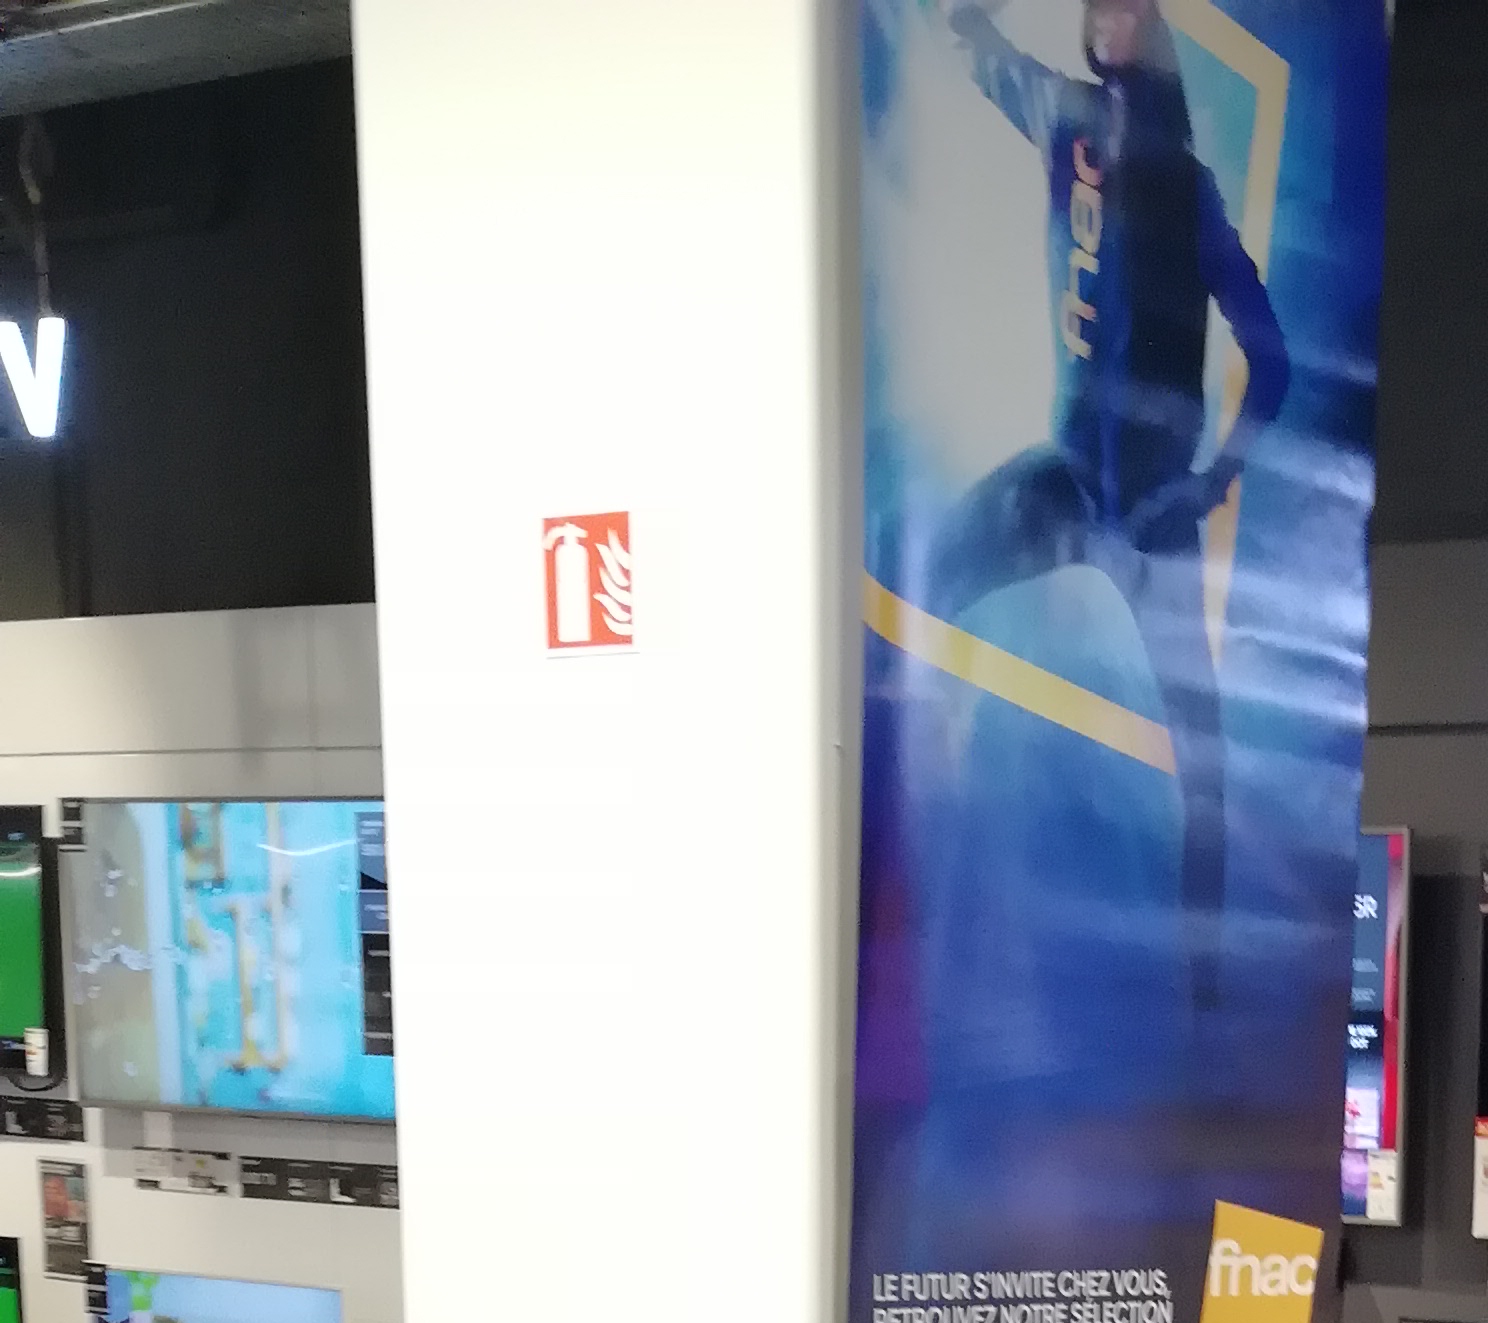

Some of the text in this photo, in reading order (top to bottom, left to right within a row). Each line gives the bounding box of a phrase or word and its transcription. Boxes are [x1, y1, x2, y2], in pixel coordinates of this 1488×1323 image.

[872, 1272, 899, 1302] LE
[901, 1270, 972, 1302] FUTUR
[973, 1269, 1056, 1300] S'INVITE
[1057, 1269, 1112, 1299] CHEZ
[1208, 1238, 1319, 1298] fnac
